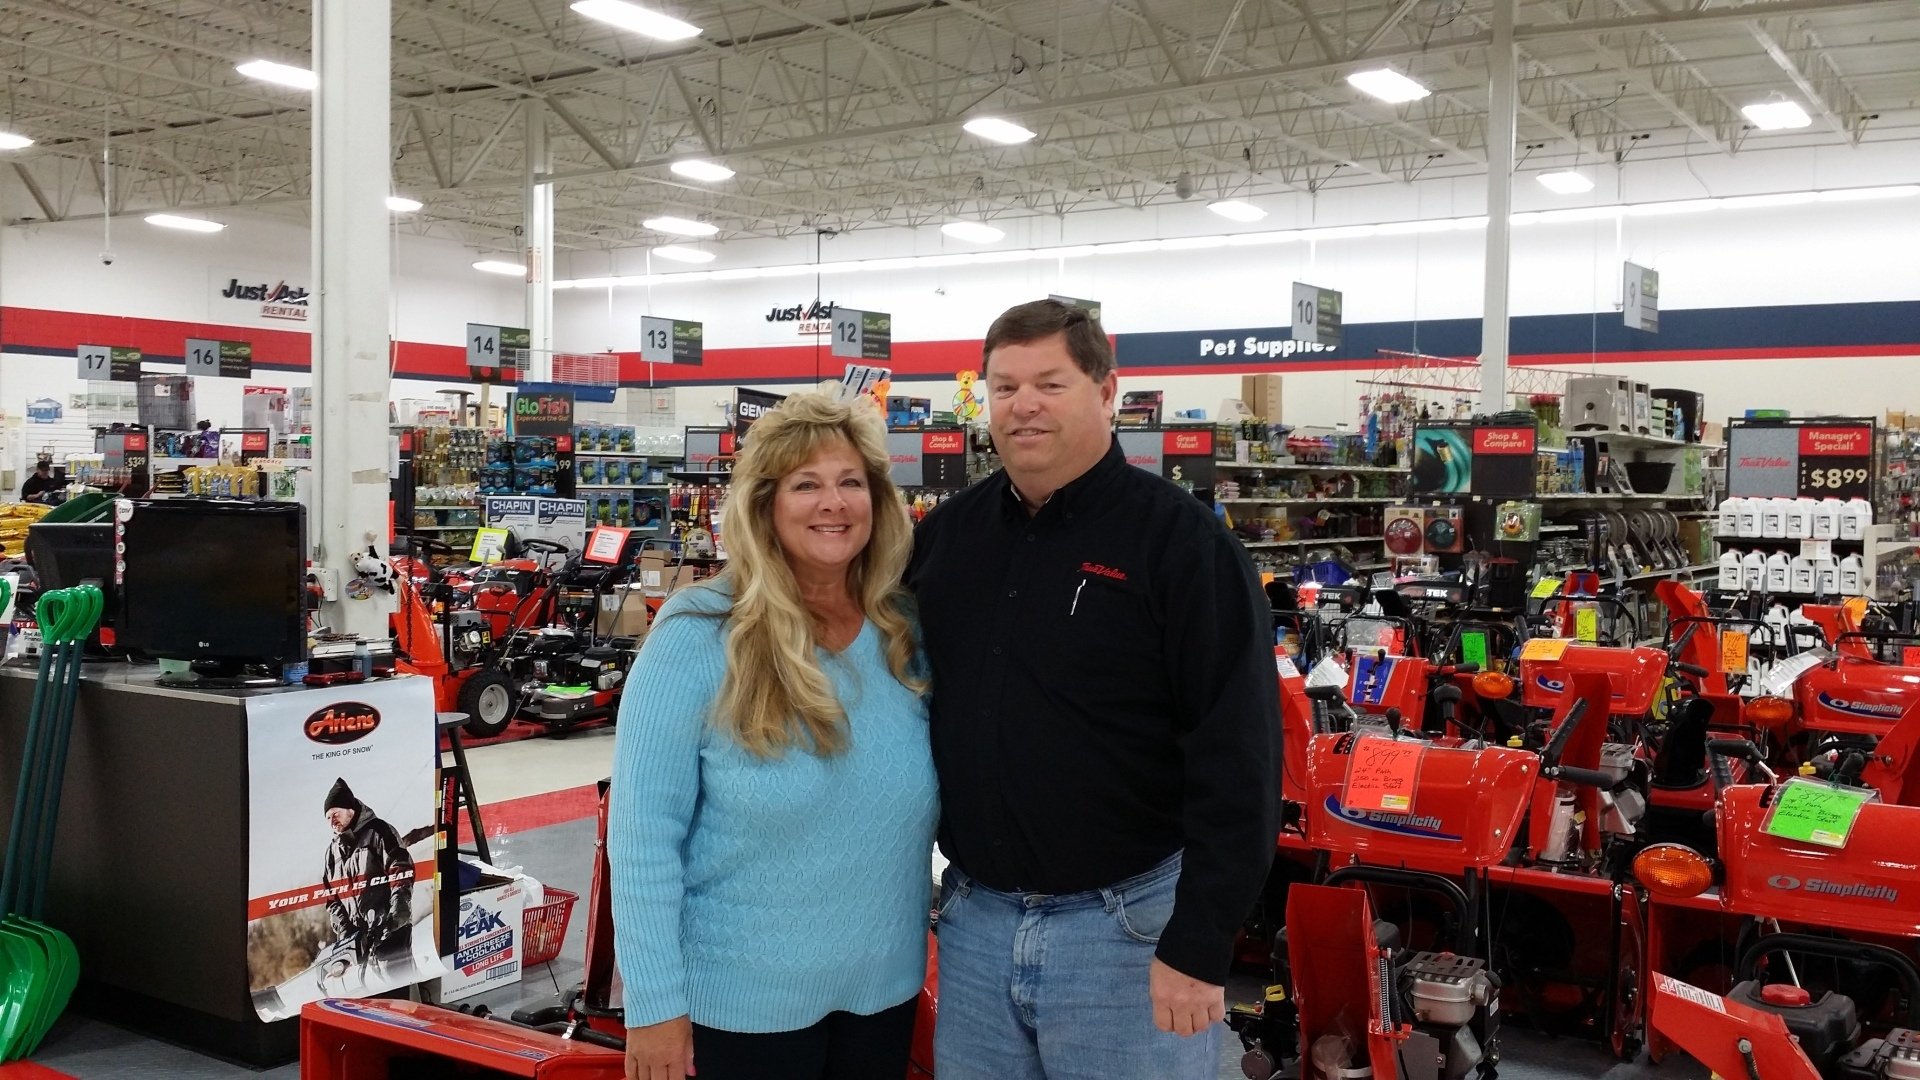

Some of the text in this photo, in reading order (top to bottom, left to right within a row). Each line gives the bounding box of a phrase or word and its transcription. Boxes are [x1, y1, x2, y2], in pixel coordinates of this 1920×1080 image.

[222, 279, 310, 306] Just Ask
[262, 305, 308, 318] RENTAL
[765, 303, 803, 322] Just
[1297, 299, 1313, 325] 10
[798, 322, 832, 332] RENTA
[837, 321, 857, 343] 12
[473, 335, 494, 355] 14
[647, 329, 668, 350] 13
[1200, 339, 1236, 357] Pet
[84, 354, 105, 370] 17
[193, 348, 214, 366] 16
[516, 397, 570, 415] GloFish
[932, 435, 947, 443] Shop
[1176, 434, 1197, 442] Great
[1483, 440, 1526, 449] Compare!
[1488, 432, 1519, 441] Shop &
[1808, 431, 1861, 442] Manager's
[929, 442, 959, 450] Compare!
[1814, 441, 1854, 452] Special!
[492, 501, 531, 511] CHAPIN
[540, 502, 585, 513] CHAPIN
[1850, 701, 1904, 714] Simplicity
[308, 708, 376, 737] Ariens
[326, 750, 341, 758] KING
[1368, 811, 1442, 831] Simplicity
[268, 870, 414, 909] YOUR PATH IS CLEAR
[1804, 878, 1898, 902] Simplicity
[457, 911, 507, 940] PEAK
[457, 931, 511, 959] ANTIFREEZE
[464, 936, 485, 948] STRENGTH
[484, 925, 511, 941] CONCENTRATE
[472, 953, 504, 972] LONG LIFE
